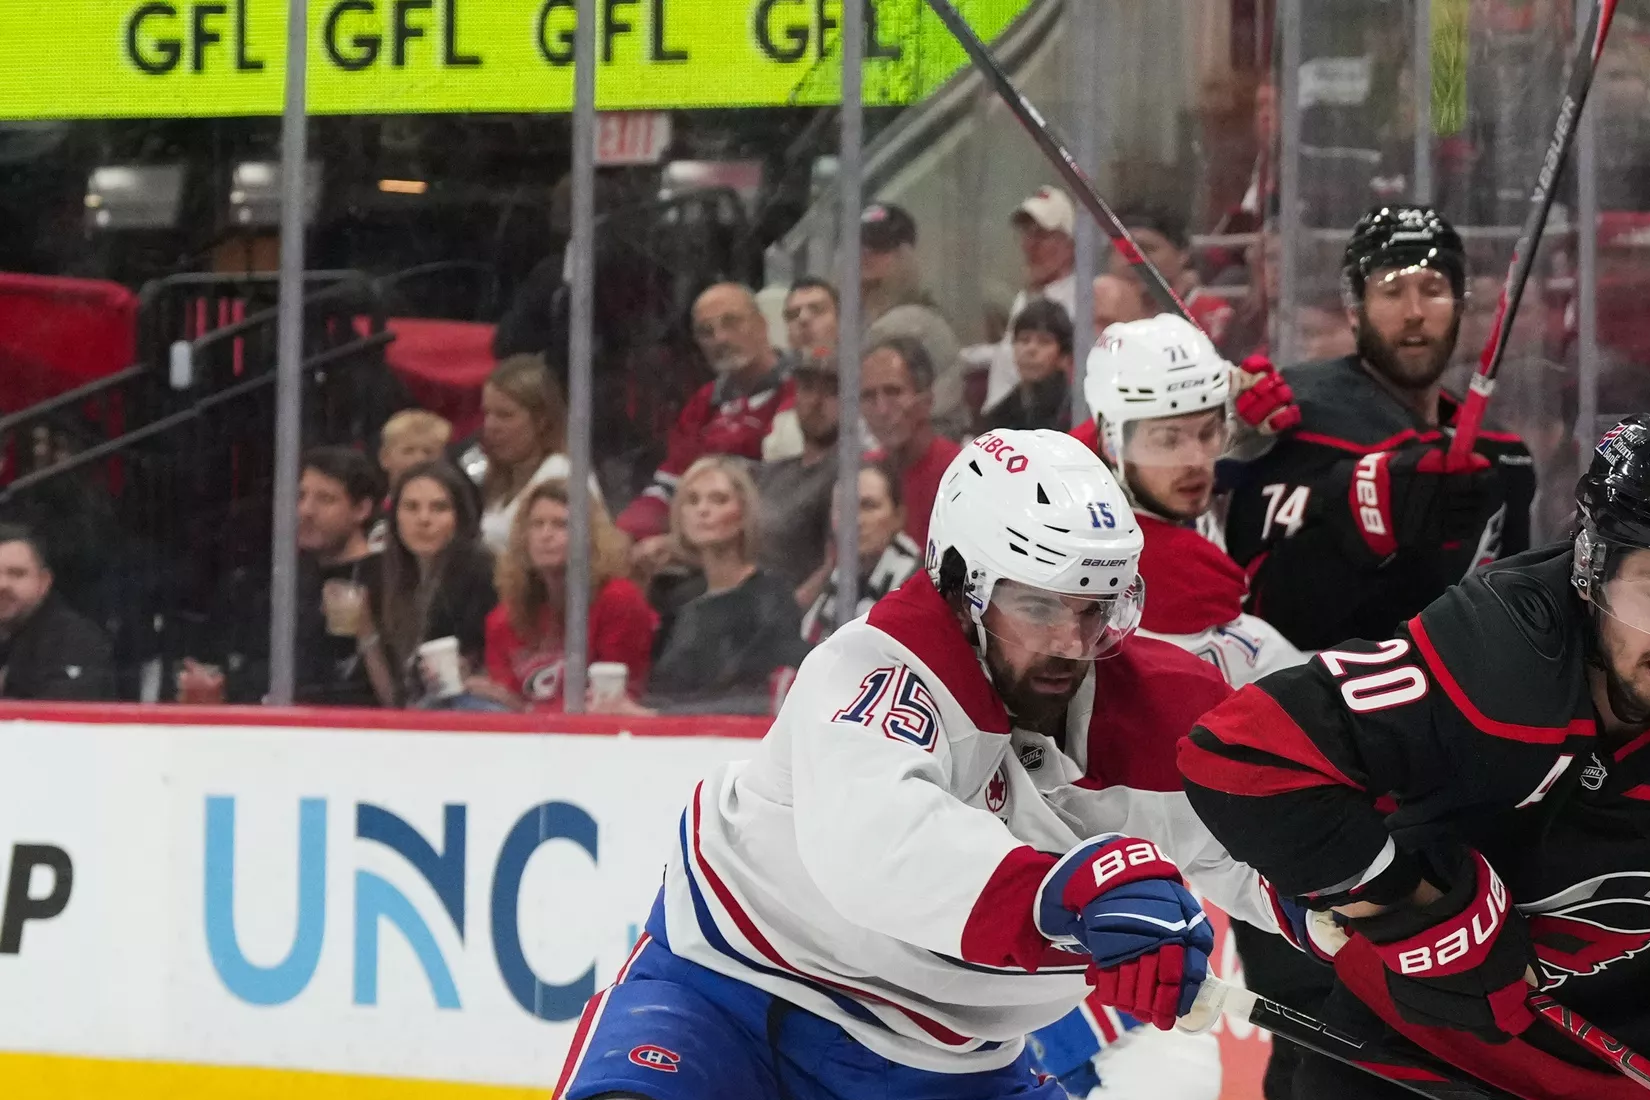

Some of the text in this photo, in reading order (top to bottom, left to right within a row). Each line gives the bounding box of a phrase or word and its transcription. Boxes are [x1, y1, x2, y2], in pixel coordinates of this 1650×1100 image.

[128, 0, 901, 75] GFL GFL GFL GFL
[1163, 344, 1189, 363] 71
[1087, 502, 1116, 529] 15
[1261, 483, 1310, 540] 74
[831, 664, 939, 753] 15
[1319, 638, 1429, 714] 20
[1020, 751, 1043, 768] NHL
[1583, 767, 1602, 777] NHL
[204, 795, 600, 1023] UNC
[1398, 854, 1507, 974] BAUE
